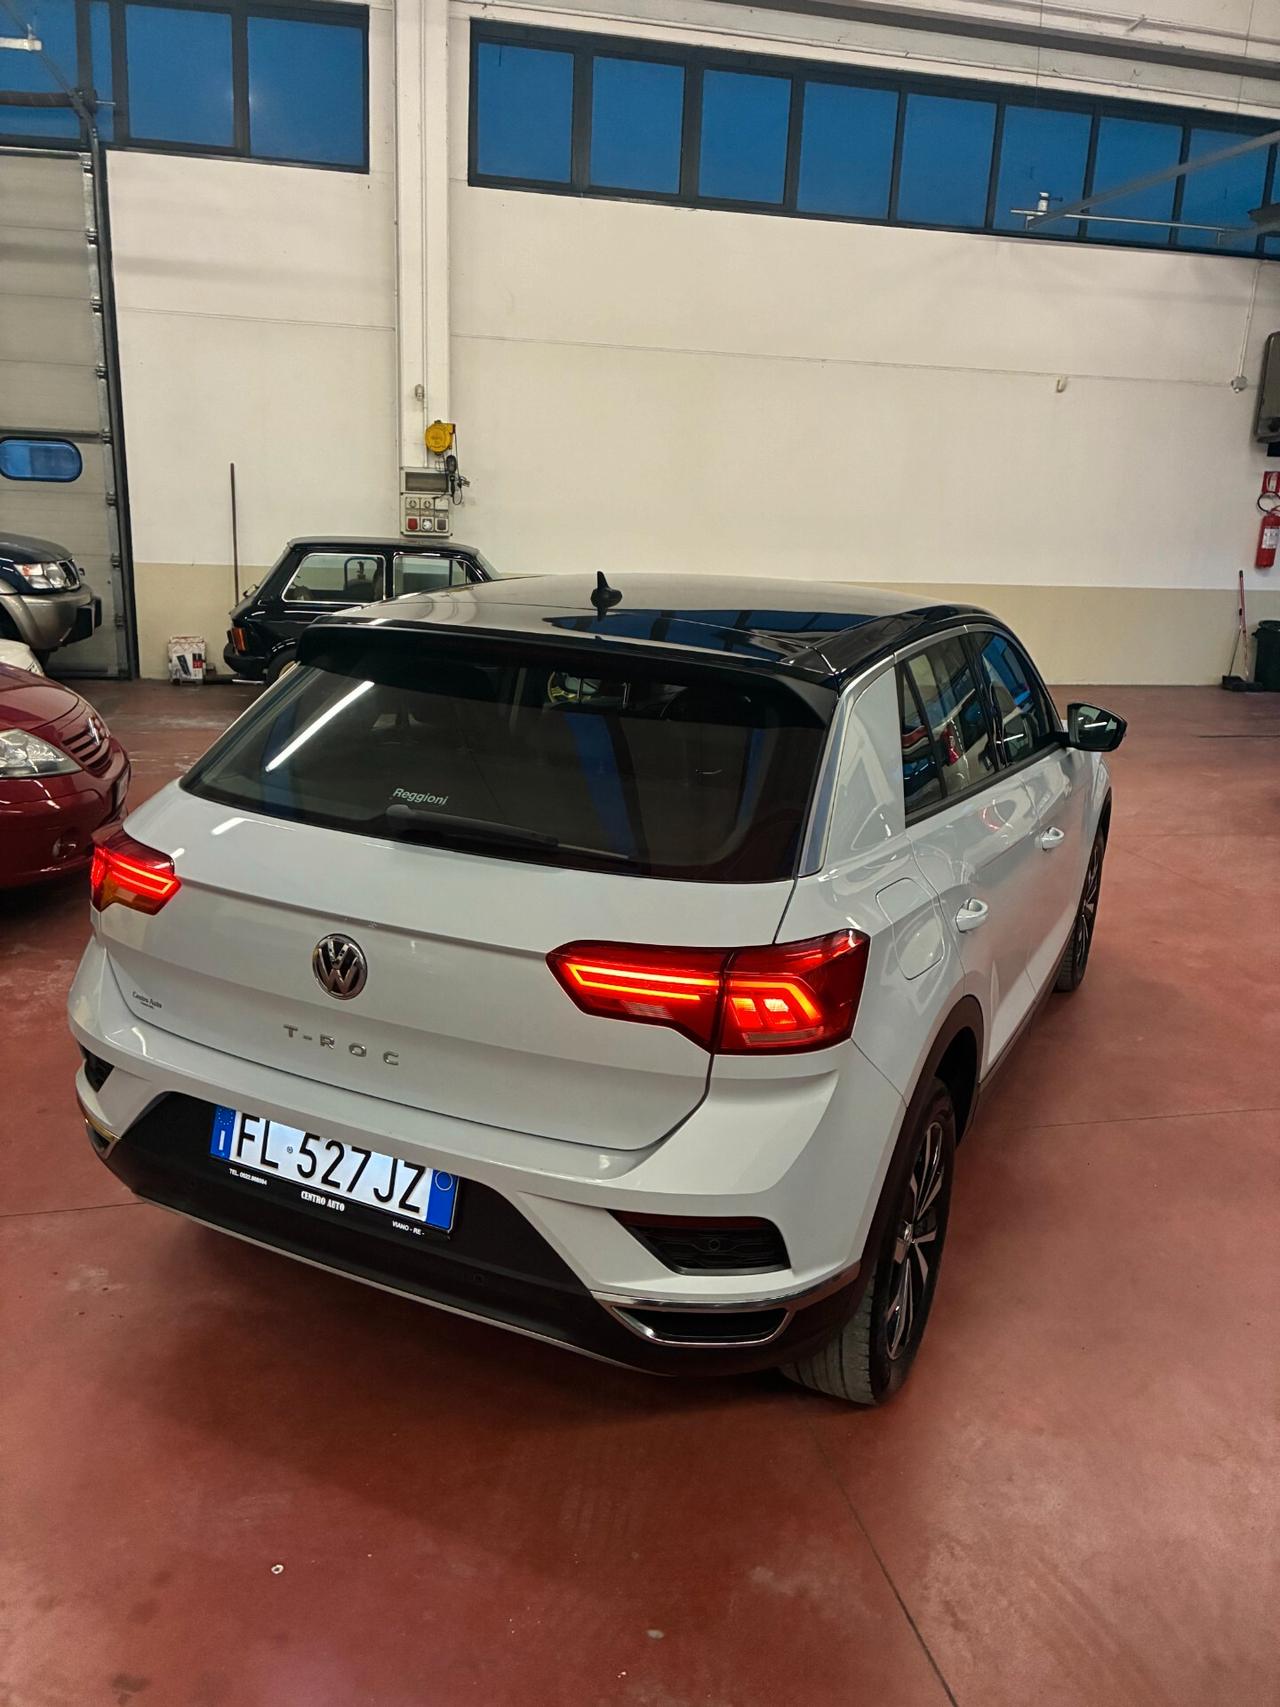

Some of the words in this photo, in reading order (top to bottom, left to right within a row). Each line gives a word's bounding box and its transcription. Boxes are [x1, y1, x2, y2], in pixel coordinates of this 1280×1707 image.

[392, 788, 448, 805] Reggioni
[283, 1024, 399, 1066] T-ROC
[237, 1112, 279, 1169] FL
[301, 1191, 326, 1206] CENTRO
[326, 1199, 345, 1211] AUTO
